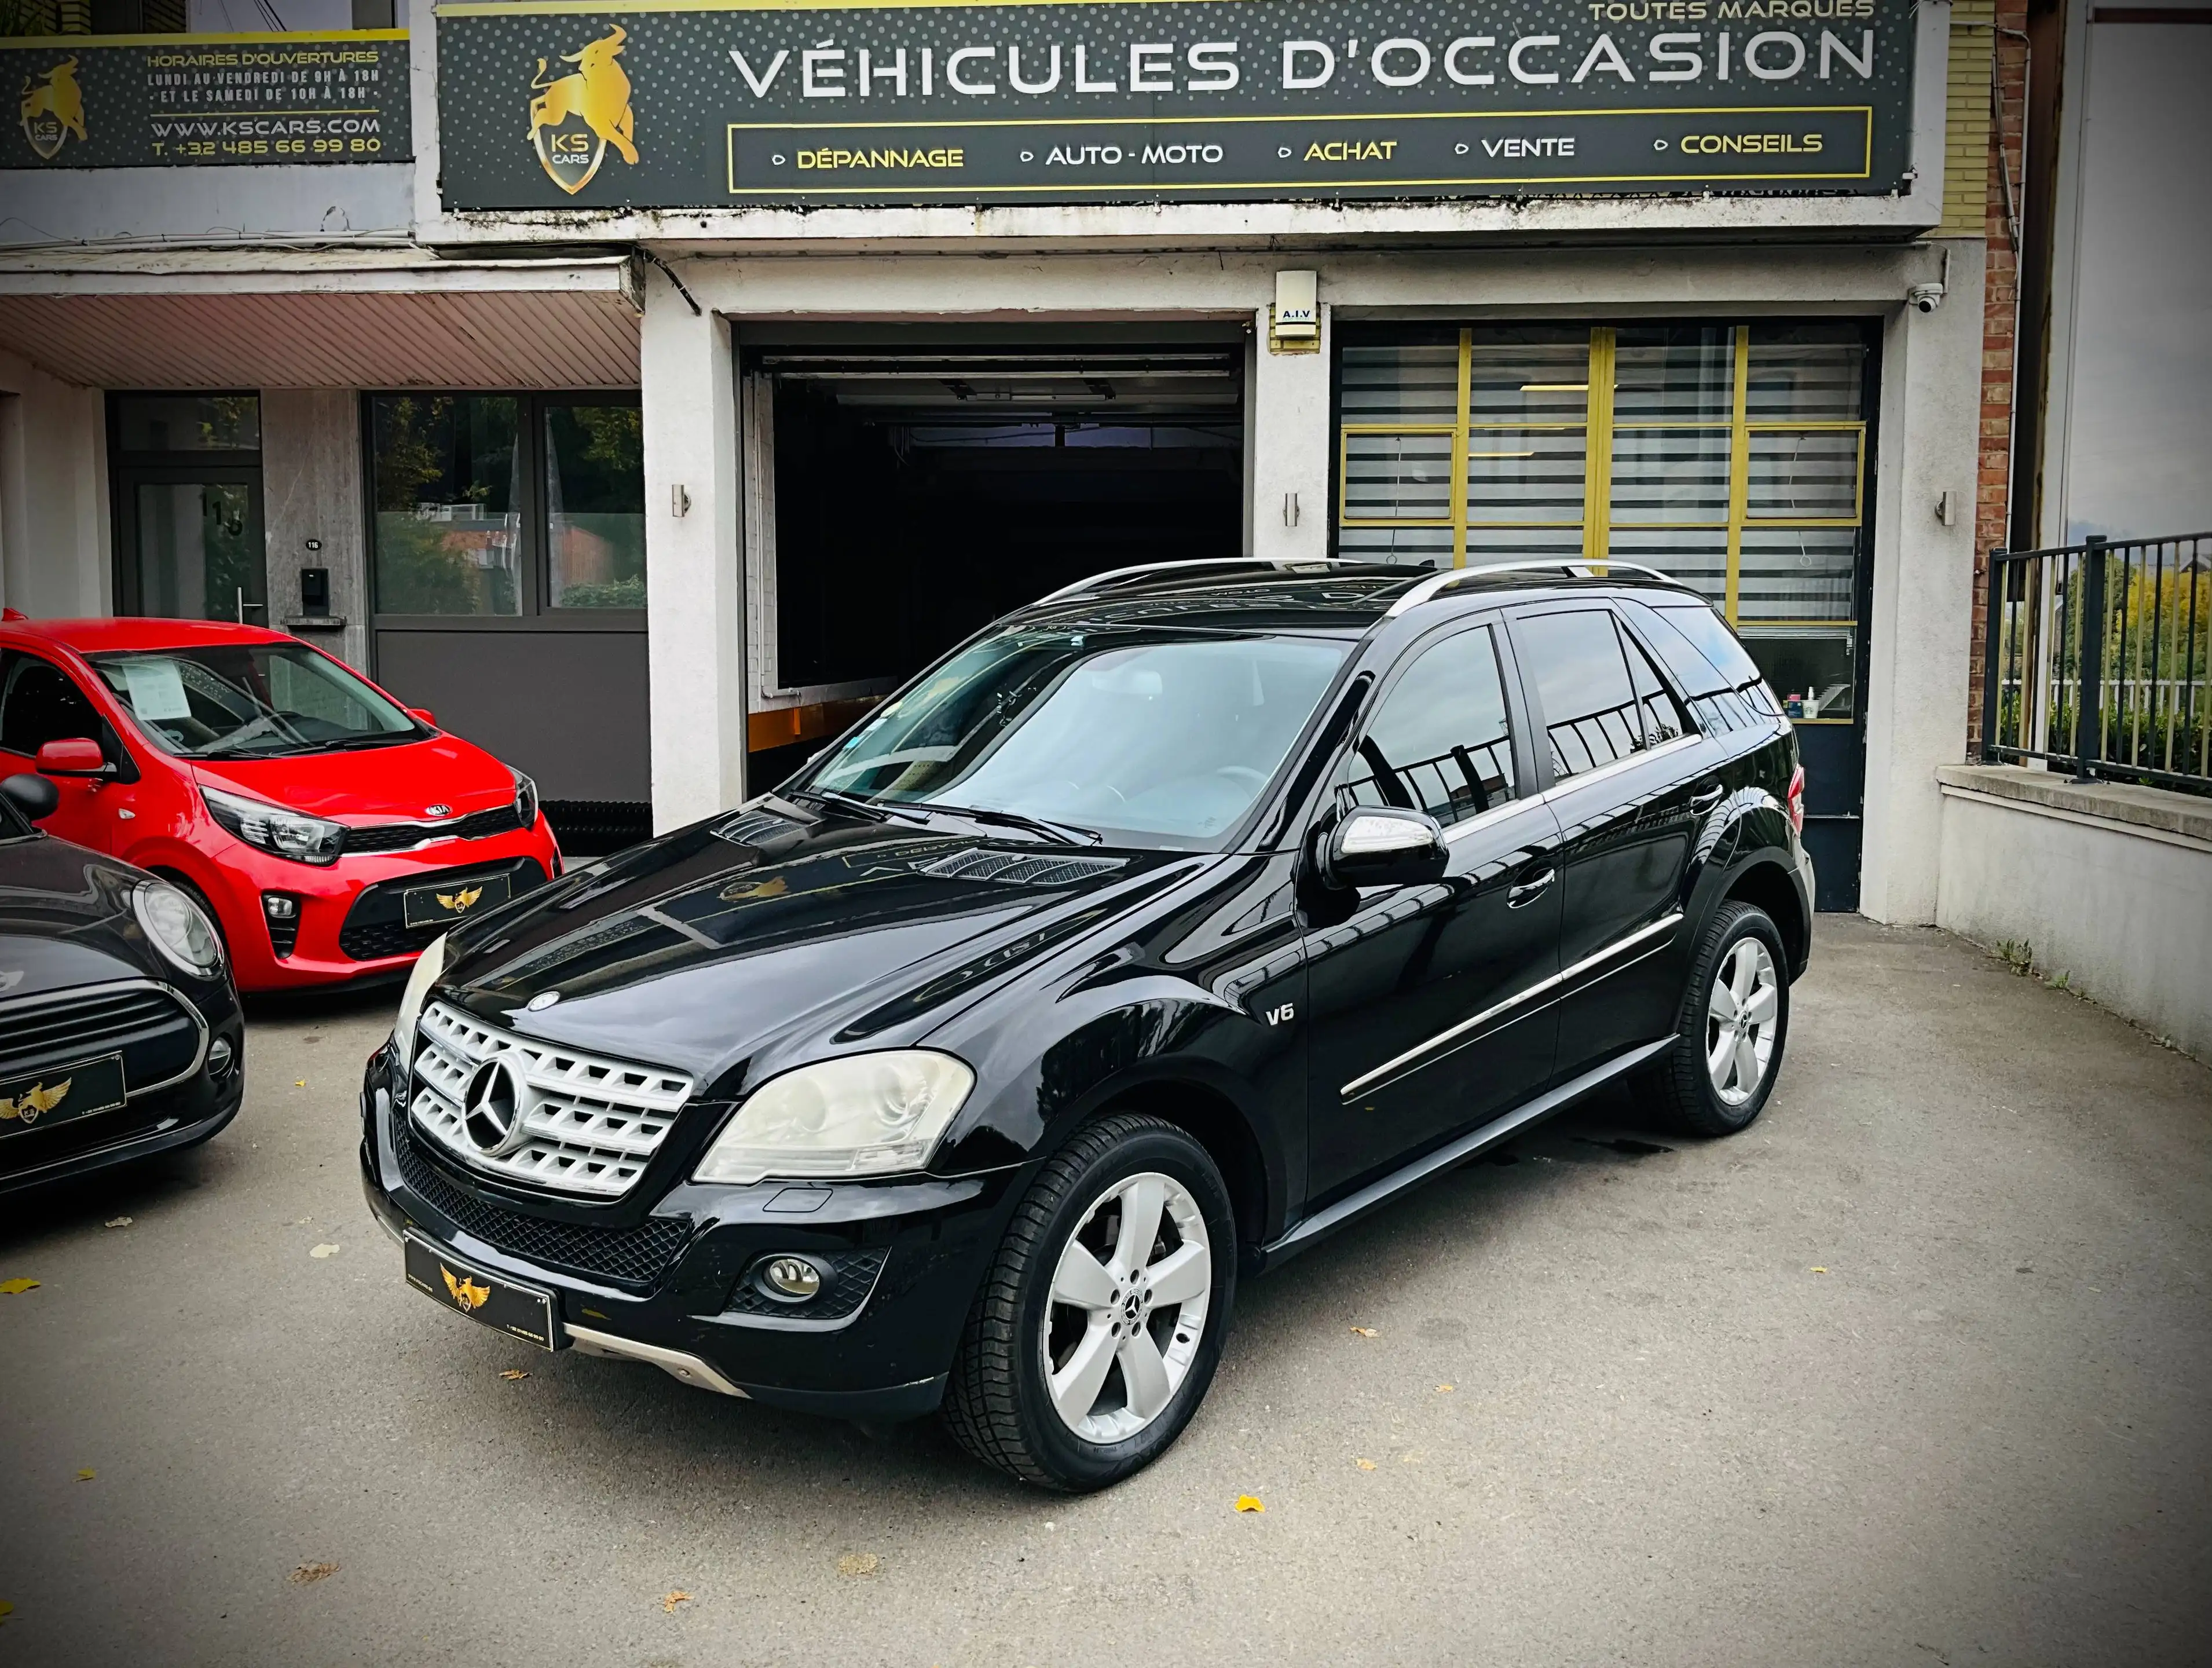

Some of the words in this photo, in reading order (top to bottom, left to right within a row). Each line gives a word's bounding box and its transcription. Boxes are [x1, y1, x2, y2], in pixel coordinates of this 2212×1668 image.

[1588, 2, 1707, 20] TOUTES
[1717, 0, 1874, 19] MARQUES
[147, 54, 239, 67] HORAIRES
[242, 51, 379, 65] D'OUVERTURES
[728, 39, 1240, 98] VÉHICULES
[1282, 29, 1873, 89] D'OCCASION
[147, 73, 186, 86] LUNDI
[194, 73, 210, 85] AU
[217, 71, 284, 85] VENDREDI
[291, 71, 307, 83] DE
[314, 70, 331, 82] 9H
[338, 68, 346, 82] À
[354, 70, 379, 82] 18H
[160, 90, 175, 103] ET
[184, 90, 199, 102] LE
[206, 89, 258, 101] SAMEDI
[266, 88, 282, 100] DE
[291, 87, 316, 100] 10H
[324, 86, 331, 99] À
[340, 87, 365, 98] 18H
[34, 122, 57, 134] KS
[151, 119, 380, 137] WWW.KSCARS.COM
[151, 142, 168, 156] T.
[175, 141, 215, 156] +32
[222, 140, 268, 154] 485
[275, 140, 305, 153] 66
[313, 139, 343, 153] 99
[350, 138, 381, 152] 80
[551, 134, 589, 152] KS
[1303, 141, 1397, 162] ACHAT
[1482, 138, 1575, 158] VENTE
[1680, 134, 1823, 154] CONSEILS
[552, 154, 589, 164] CARS
[797, 147, 964, 169] DÉPANNAGE
[1045, 146, 1122, 166] AUTO
[1141, 144, 1224, 164] MOTO
[1283, 310, 1310, 318] A.I.V
[1265, 1003, 1295, 1026] V6
